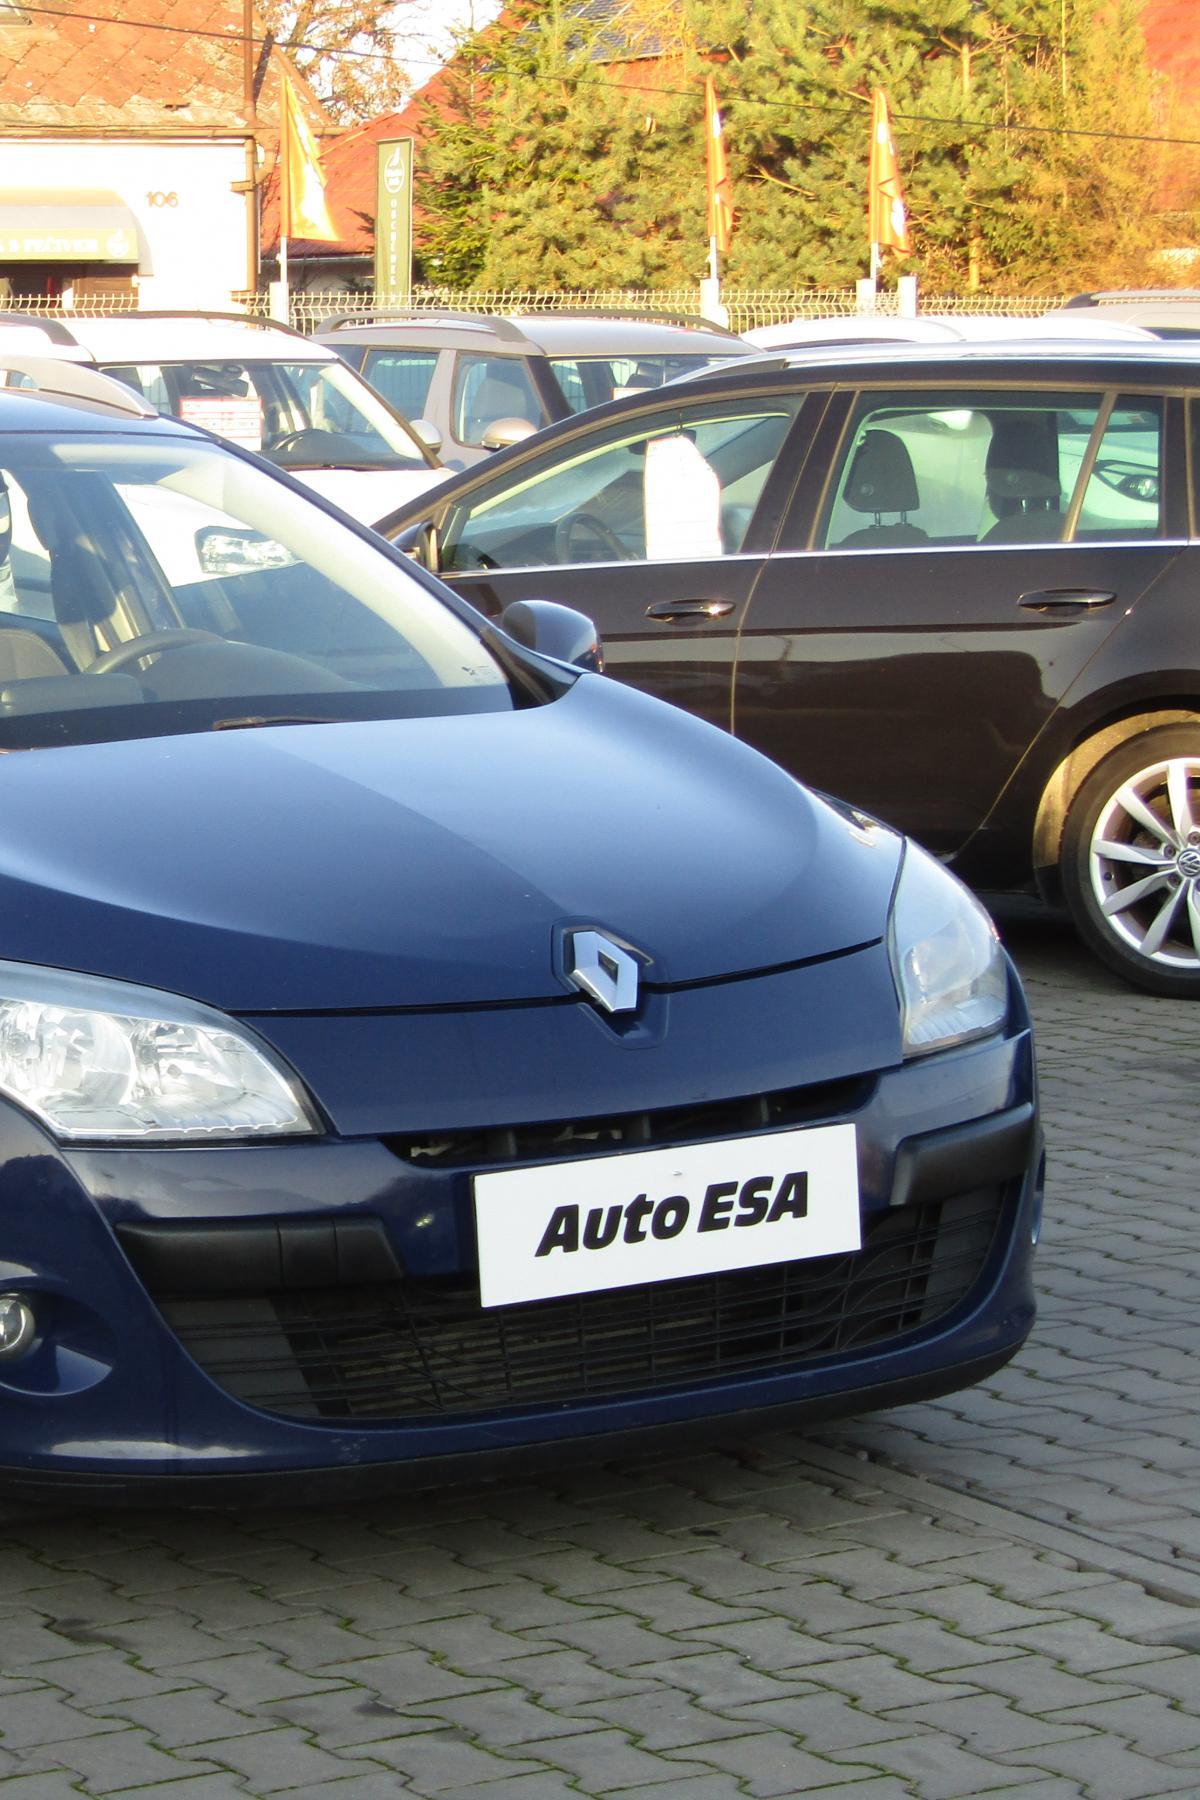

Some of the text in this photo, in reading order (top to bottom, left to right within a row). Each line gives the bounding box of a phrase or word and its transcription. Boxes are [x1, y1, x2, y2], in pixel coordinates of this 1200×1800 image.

[146, 191, 178, 208] 106
[534, 1171, 808, 1257] Auto ESA
